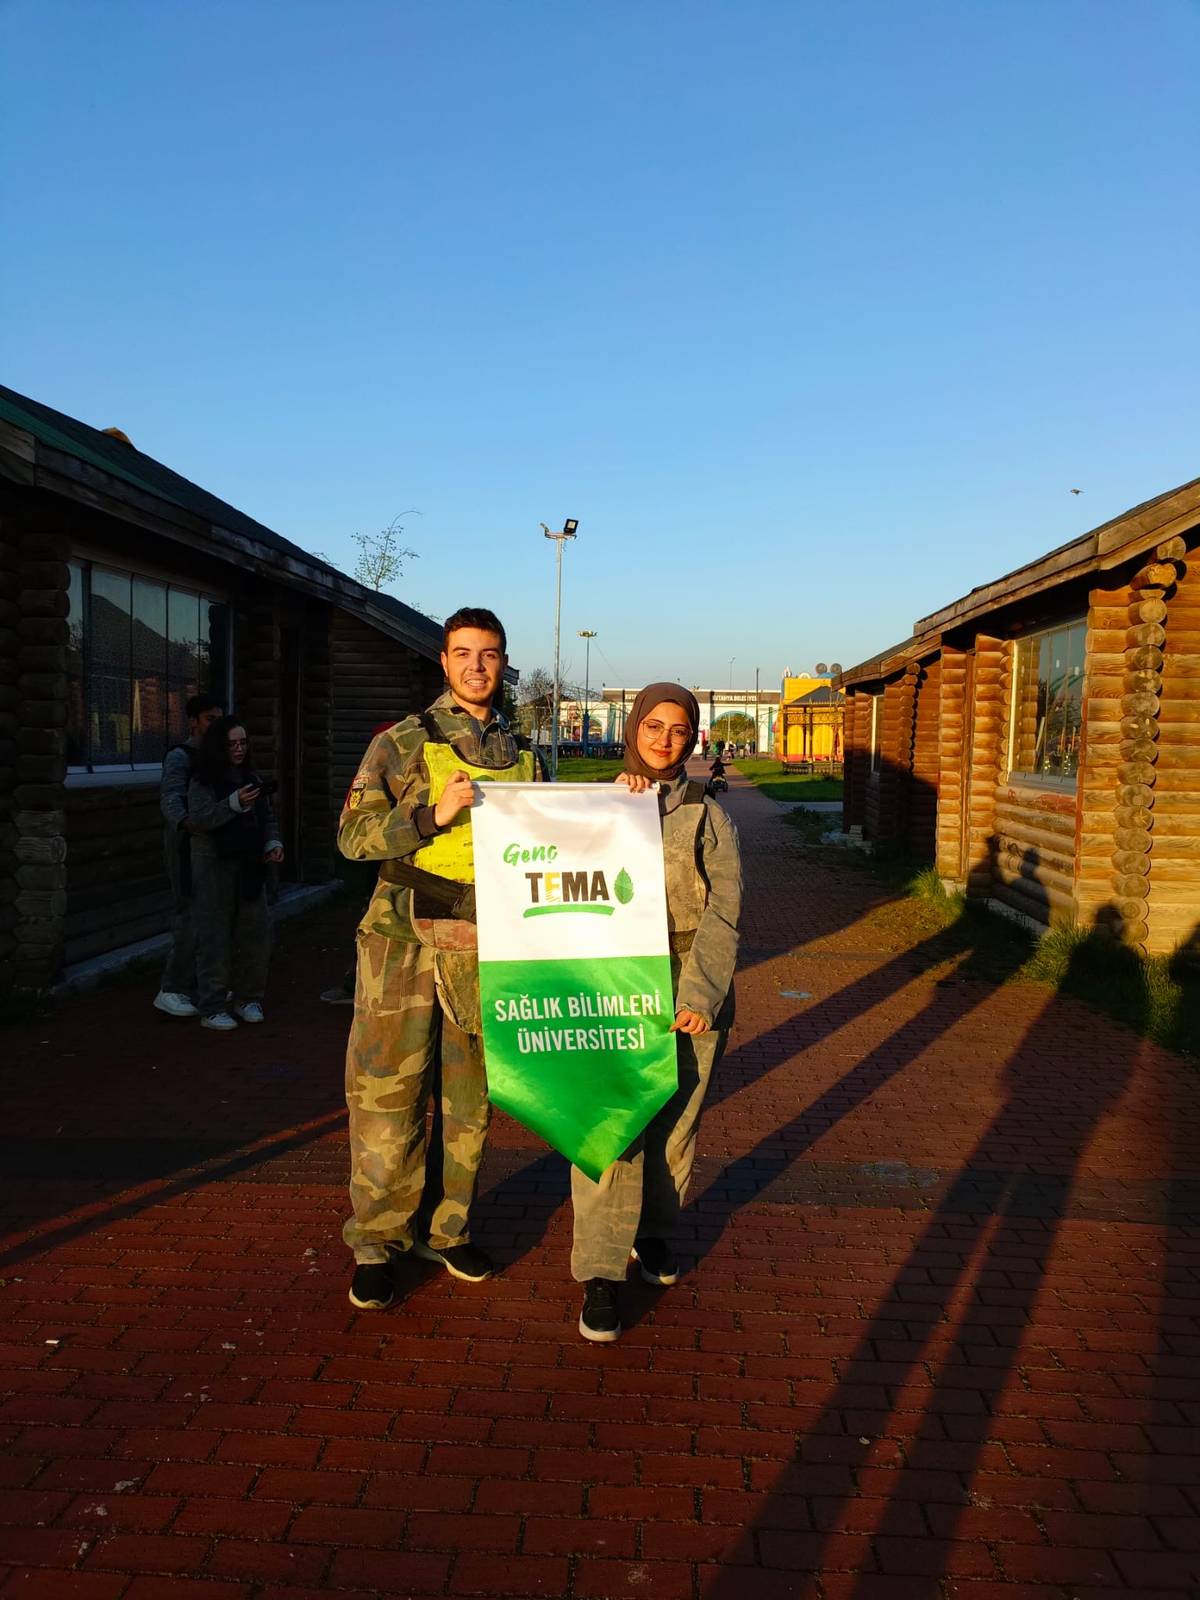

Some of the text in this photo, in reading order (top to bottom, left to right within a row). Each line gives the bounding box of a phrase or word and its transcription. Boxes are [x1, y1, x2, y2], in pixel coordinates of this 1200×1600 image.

[503, 843, 558, 866] Genç
[525, 871, 610, 903] TEMA
[495, 989, 661, 1021] SAĞLIK BİLİMLERİ
[517, 1023, 645, 1054] ÜNİVERSİTESİ
